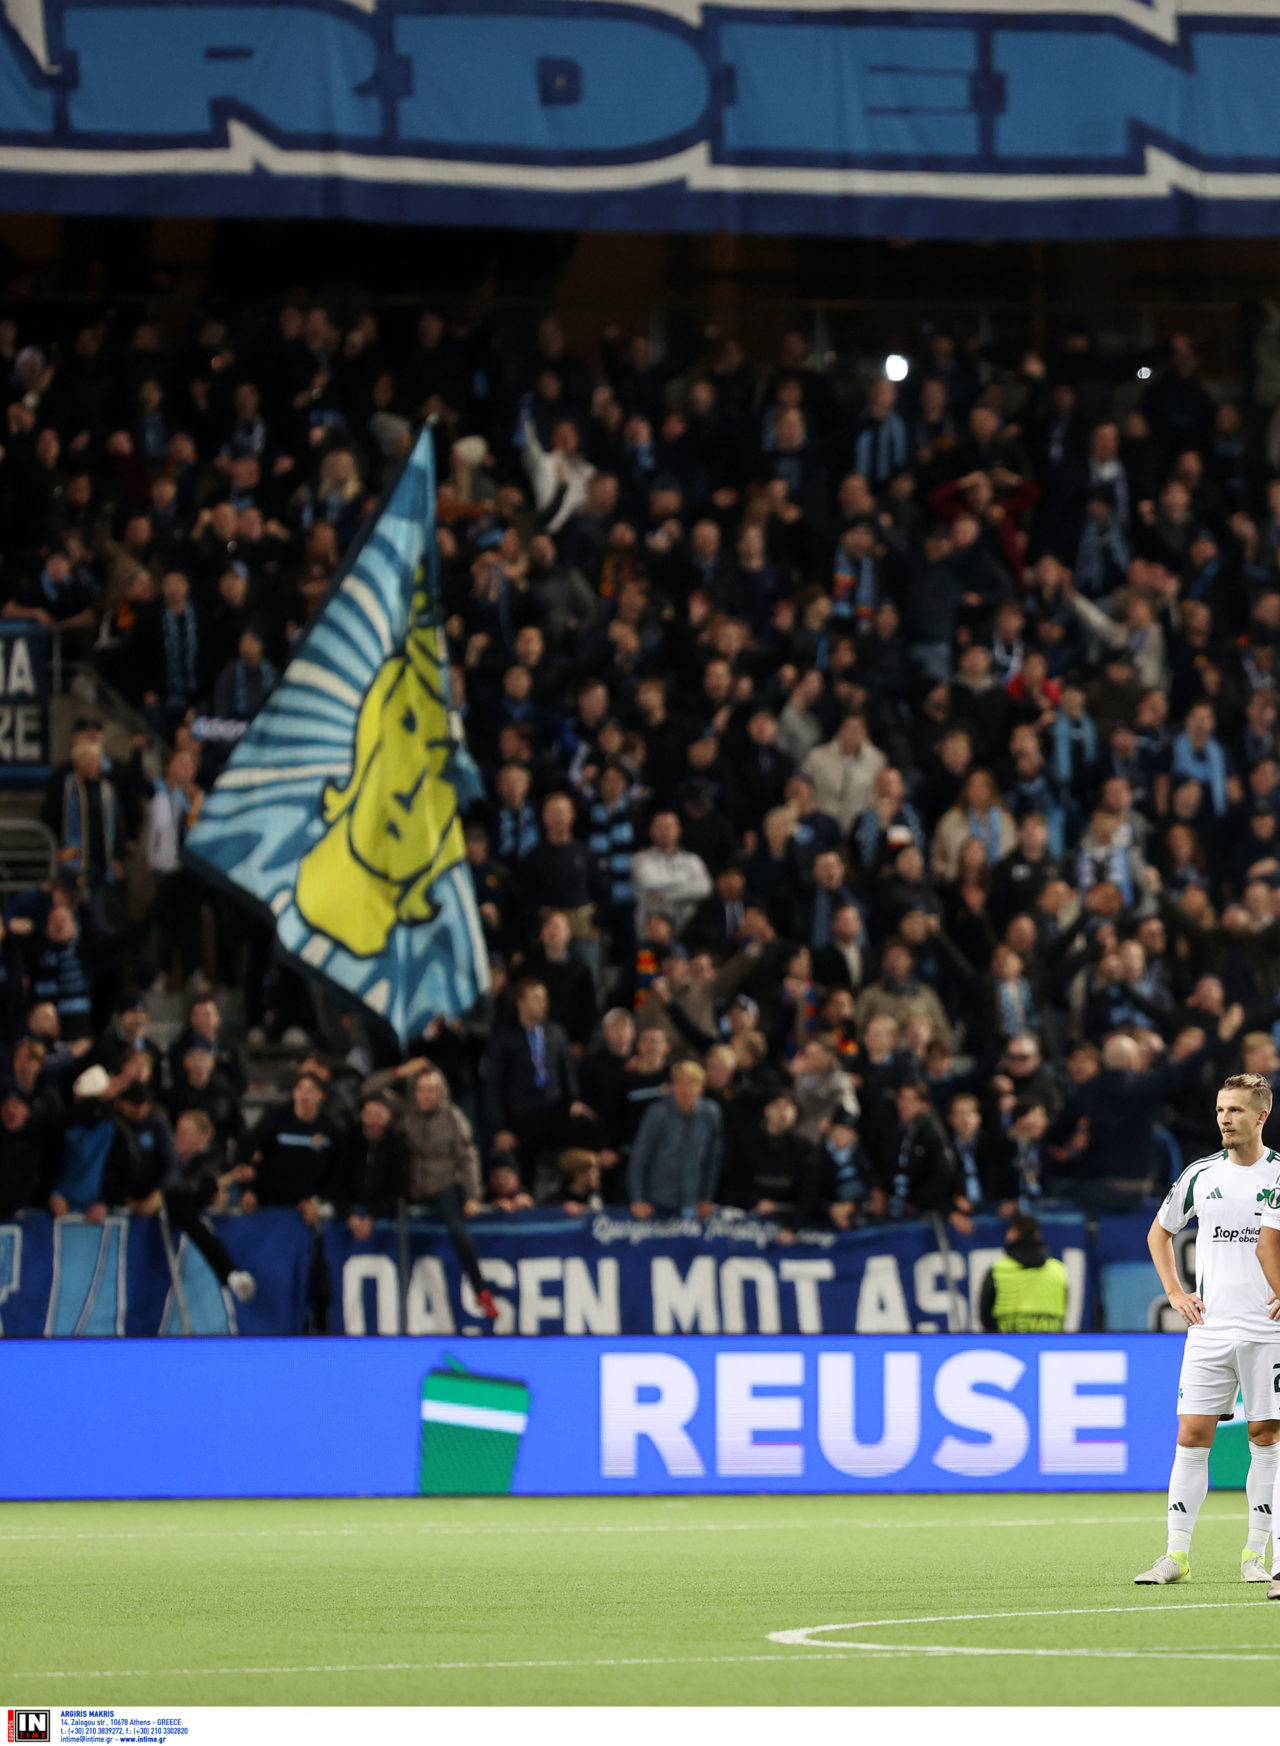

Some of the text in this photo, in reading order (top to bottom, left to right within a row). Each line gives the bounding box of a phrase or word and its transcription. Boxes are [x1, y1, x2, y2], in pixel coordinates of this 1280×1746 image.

[1213, 1225, 1239, 1242] Stop
[651, 1256, 835, 1334] MOT
[600, 1349, 1128, 1477] REUSE
